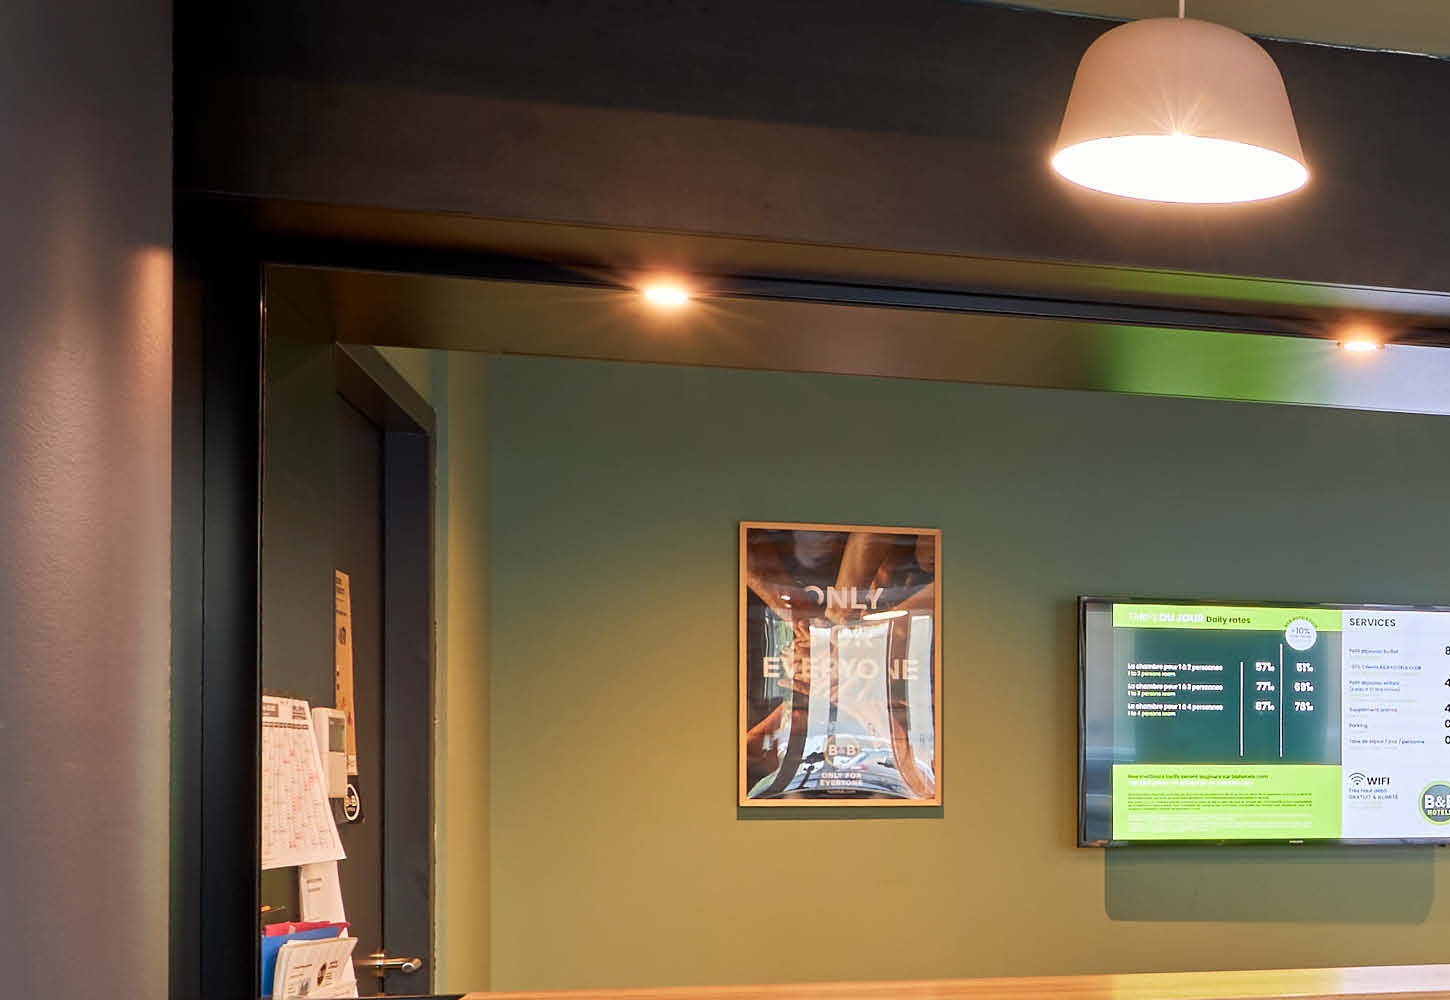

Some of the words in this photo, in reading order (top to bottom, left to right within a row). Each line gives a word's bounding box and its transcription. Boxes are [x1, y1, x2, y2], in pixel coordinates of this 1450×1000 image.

[1206, 616, 1227, 624] Daily
[1229, 616, 1251, 624] rates
[1349, 617, 1396, 627] SERVICES
[1367, 777, 1390, 785] WIFI
